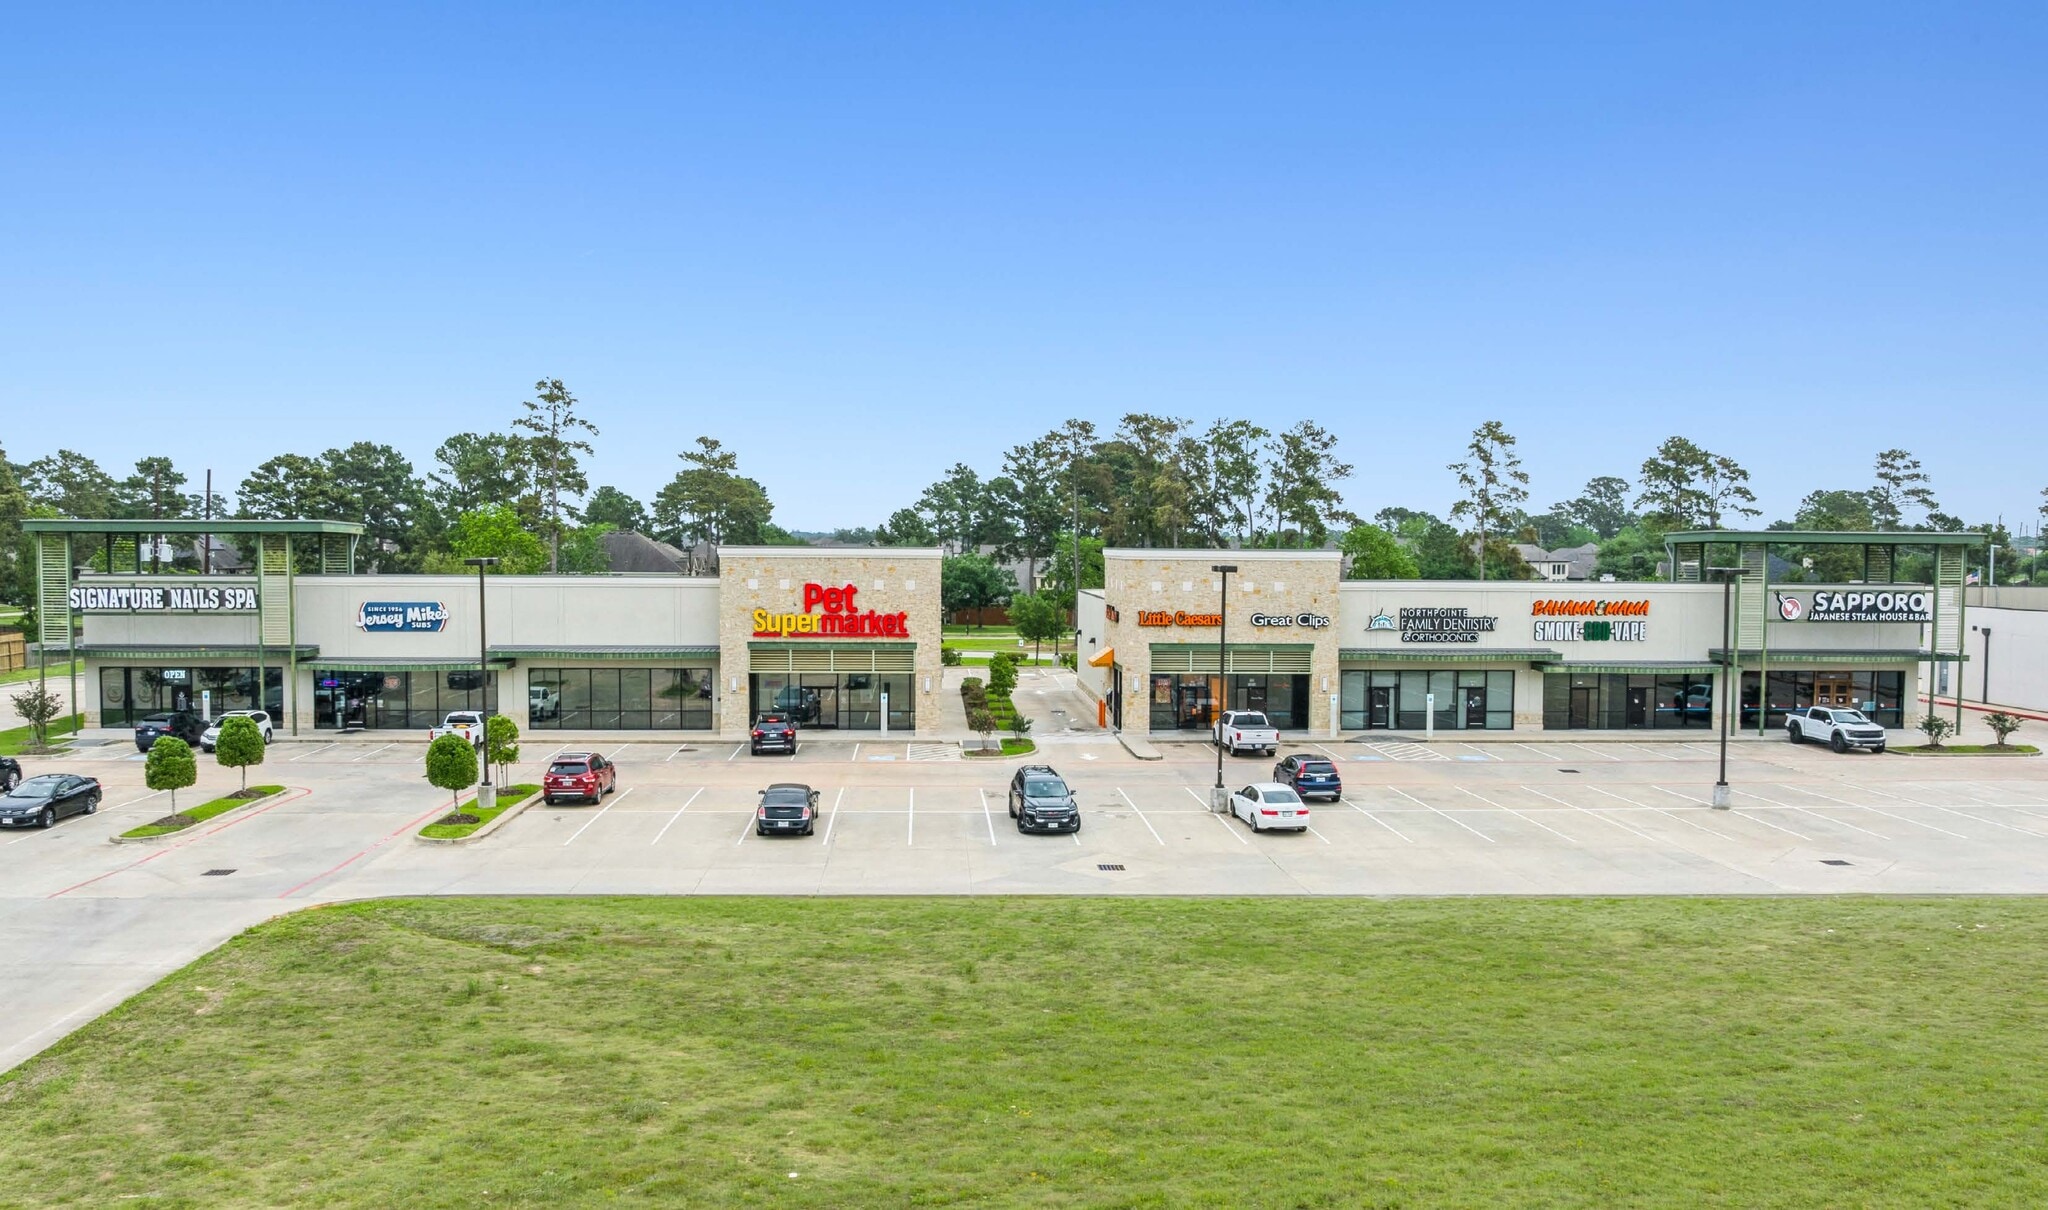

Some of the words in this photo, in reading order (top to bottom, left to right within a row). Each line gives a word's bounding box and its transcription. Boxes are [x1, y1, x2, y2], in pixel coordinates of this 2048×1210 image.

[69, 587, 165, 610] SIGNATURE
[170, 587, 220, 610] NAILS
[224, 587, 258, 610] SPA
[803, 583, 858, 613] Pet
[1813, 591, 1926, 612] SAPPORO
[355, 611, 404, 628] Jersey
[406, 605, 450, 623] Mike's
[1400, 608, 1469, 617] NORTHPOINTE
[1531, 600, 1597, 617] BAHAMA
[1603, 600, 1650, 617] MAMA
[1809, 612, 1850, 621] JAPANESE
[1851, 612, 1878, 621] STEAK
[1879, 612, 1907, 621] HOUSE
[411, 621, 432, 629] SUBS
[752, 608, 908, 637] Supermarket
[1138, 610, 1173, 626] Little
[1174, 610, 1222, 626] Caesars
[1251, 613, 1292, 626] Great
[1297, 613, 1330, 629] Clips
[1400, 618, 1441, 630] FAMILY
[1443, 618, 1498, 630] DENTISTRY
[1411, 633, 1480, 642] ORTHODONTICS
[1535, 621, 1580, 641] SMOKE
[1613, 621, 1647, 641] VAPE
[164, 670, 186, 679] OPEN
